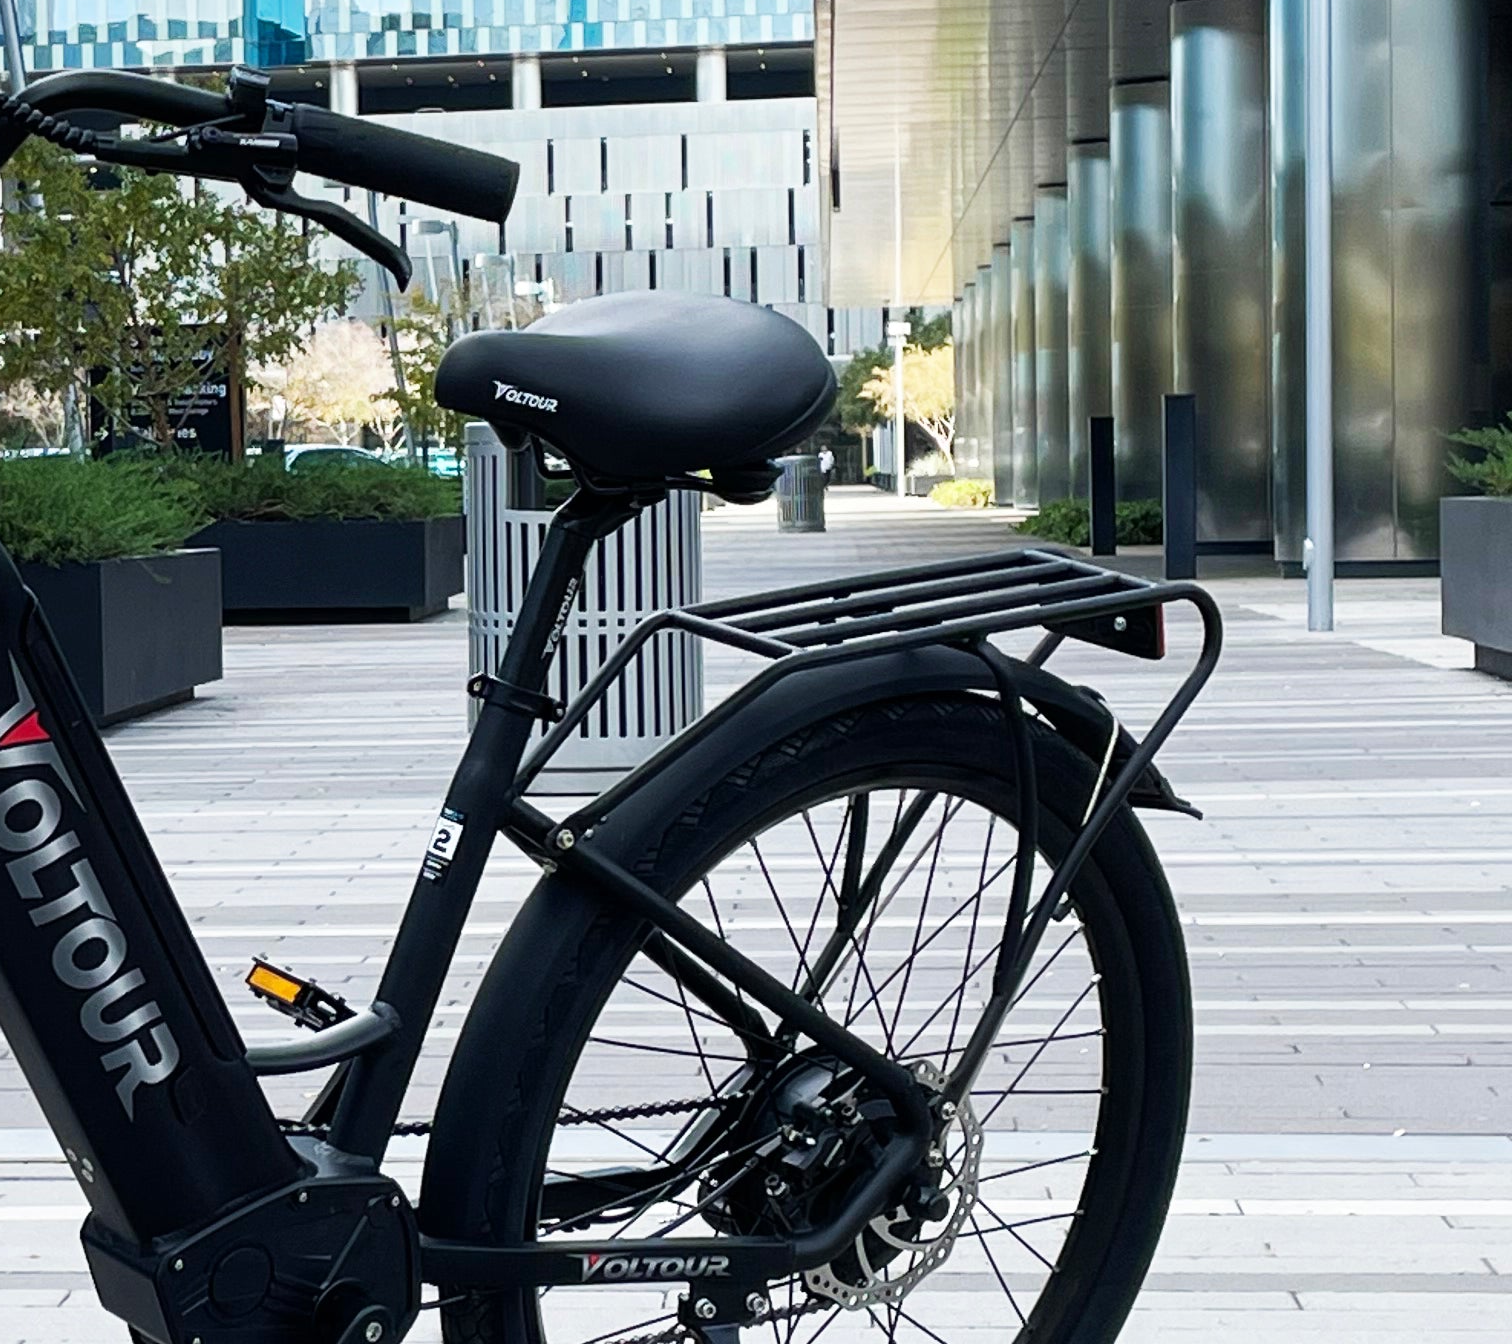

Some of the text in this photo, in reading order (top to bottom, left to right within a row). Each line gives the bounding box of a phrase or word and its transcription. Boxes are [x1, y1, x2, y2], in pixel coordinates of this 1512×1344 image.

[493, 380, 558, 412] VOLTOUR
[541, 578, 578, 659] VOLTOUR
[433, 828, 451, 853] 2
[567, 1252, 731, 1282] VOLTOUR
